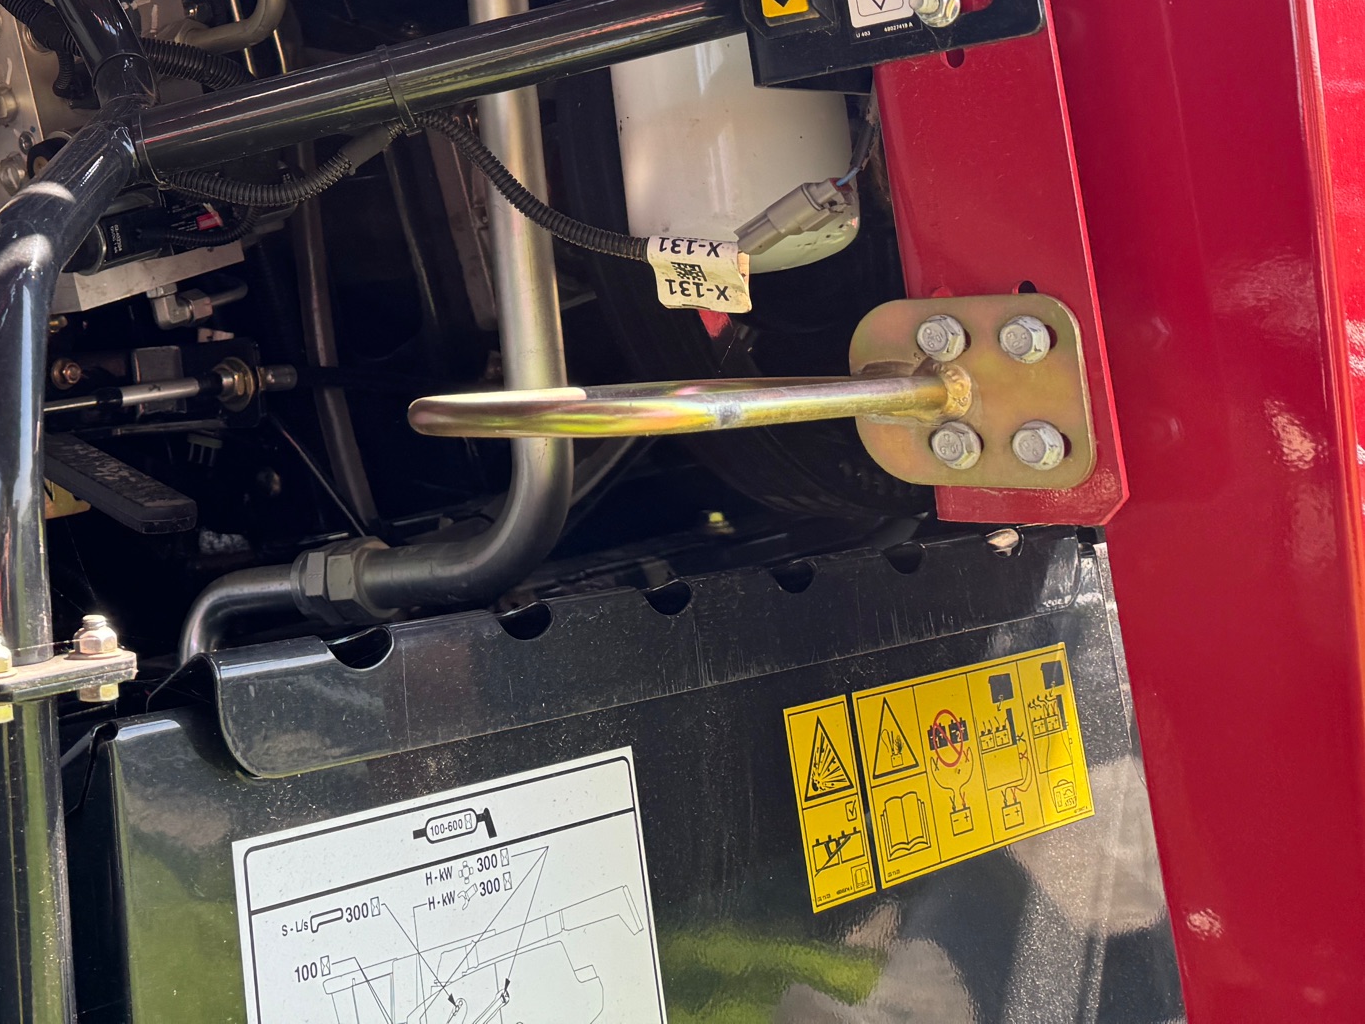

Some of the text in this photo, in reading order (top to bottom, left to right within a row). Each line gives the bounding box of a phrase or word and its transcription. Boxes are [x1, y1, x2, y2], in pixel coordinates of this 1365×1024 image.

[659, 236, 723, 258] X-131
[665, 278, 730, 301] X-131
[430, 818, 463, 836] 100-600
[476, 853, 498, 872] 300
[479, 877, 501, 897] 300
[345, 902, 369, 923] 300
[294, 962, 318, 983] 100
